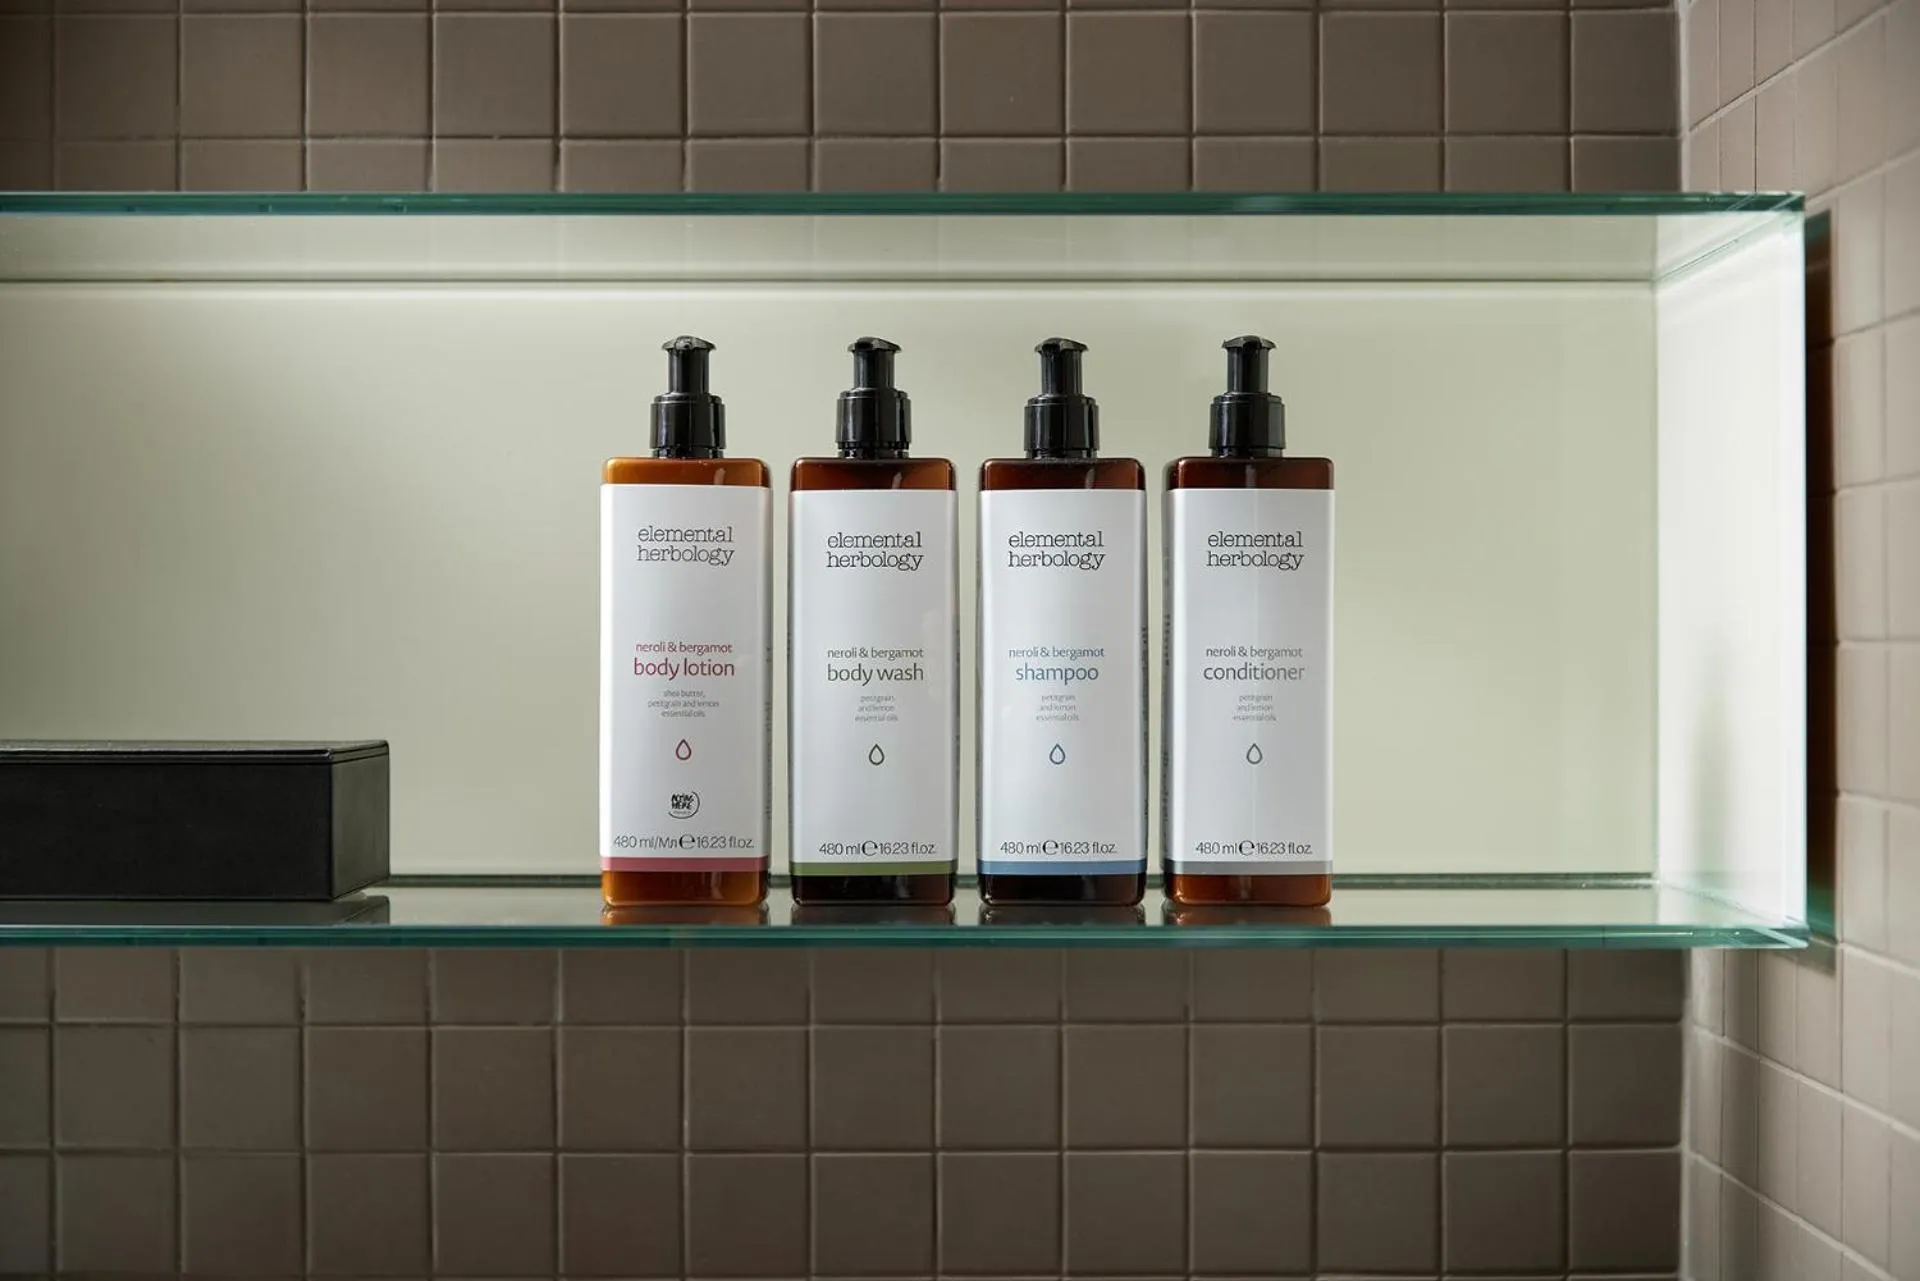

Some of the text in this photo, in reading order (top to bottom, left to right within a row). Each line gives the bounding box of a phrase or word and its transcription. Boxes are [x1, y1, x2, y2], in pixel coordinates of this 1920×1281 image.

[638, 525, 734, 542] elemental
[827, 531, 922, 548] elemental
[1009, 531, 1104, 548] elemental
[1208, 531, 1303, 548] elemental
[636, 545, 735, 566] herbology
[826, 551, 924, 571] herbology
[1008, 550, 1106, 571] herbology
[1206, 550, 1304, 571] herbology
[635, 641, 733, 656] neroli & bergamot
[827, 647, 924, 661] neroli & bergamot
[1009, 646, 1105, 661] neroli & bergamot
[1206, 645, 1303, 661] neroli & bergamot
[634, 657, 735, 681] body lotion
[827, 662, 924, 687] body wash
[1016, 662, 1099, 686] shampoo
[1203, 662, 1305, 681] conditioner
[613, 835, 637, 849] 480
[819, 843, 843, 855] 480
[845, 843, 861, 855] ml
[1000, 842, 1024, 855] 480
[1026, 841, 1041, 854] ml
[1196, 842, 1220, 855] 480
[1222, 842, 1238, 855] ml
